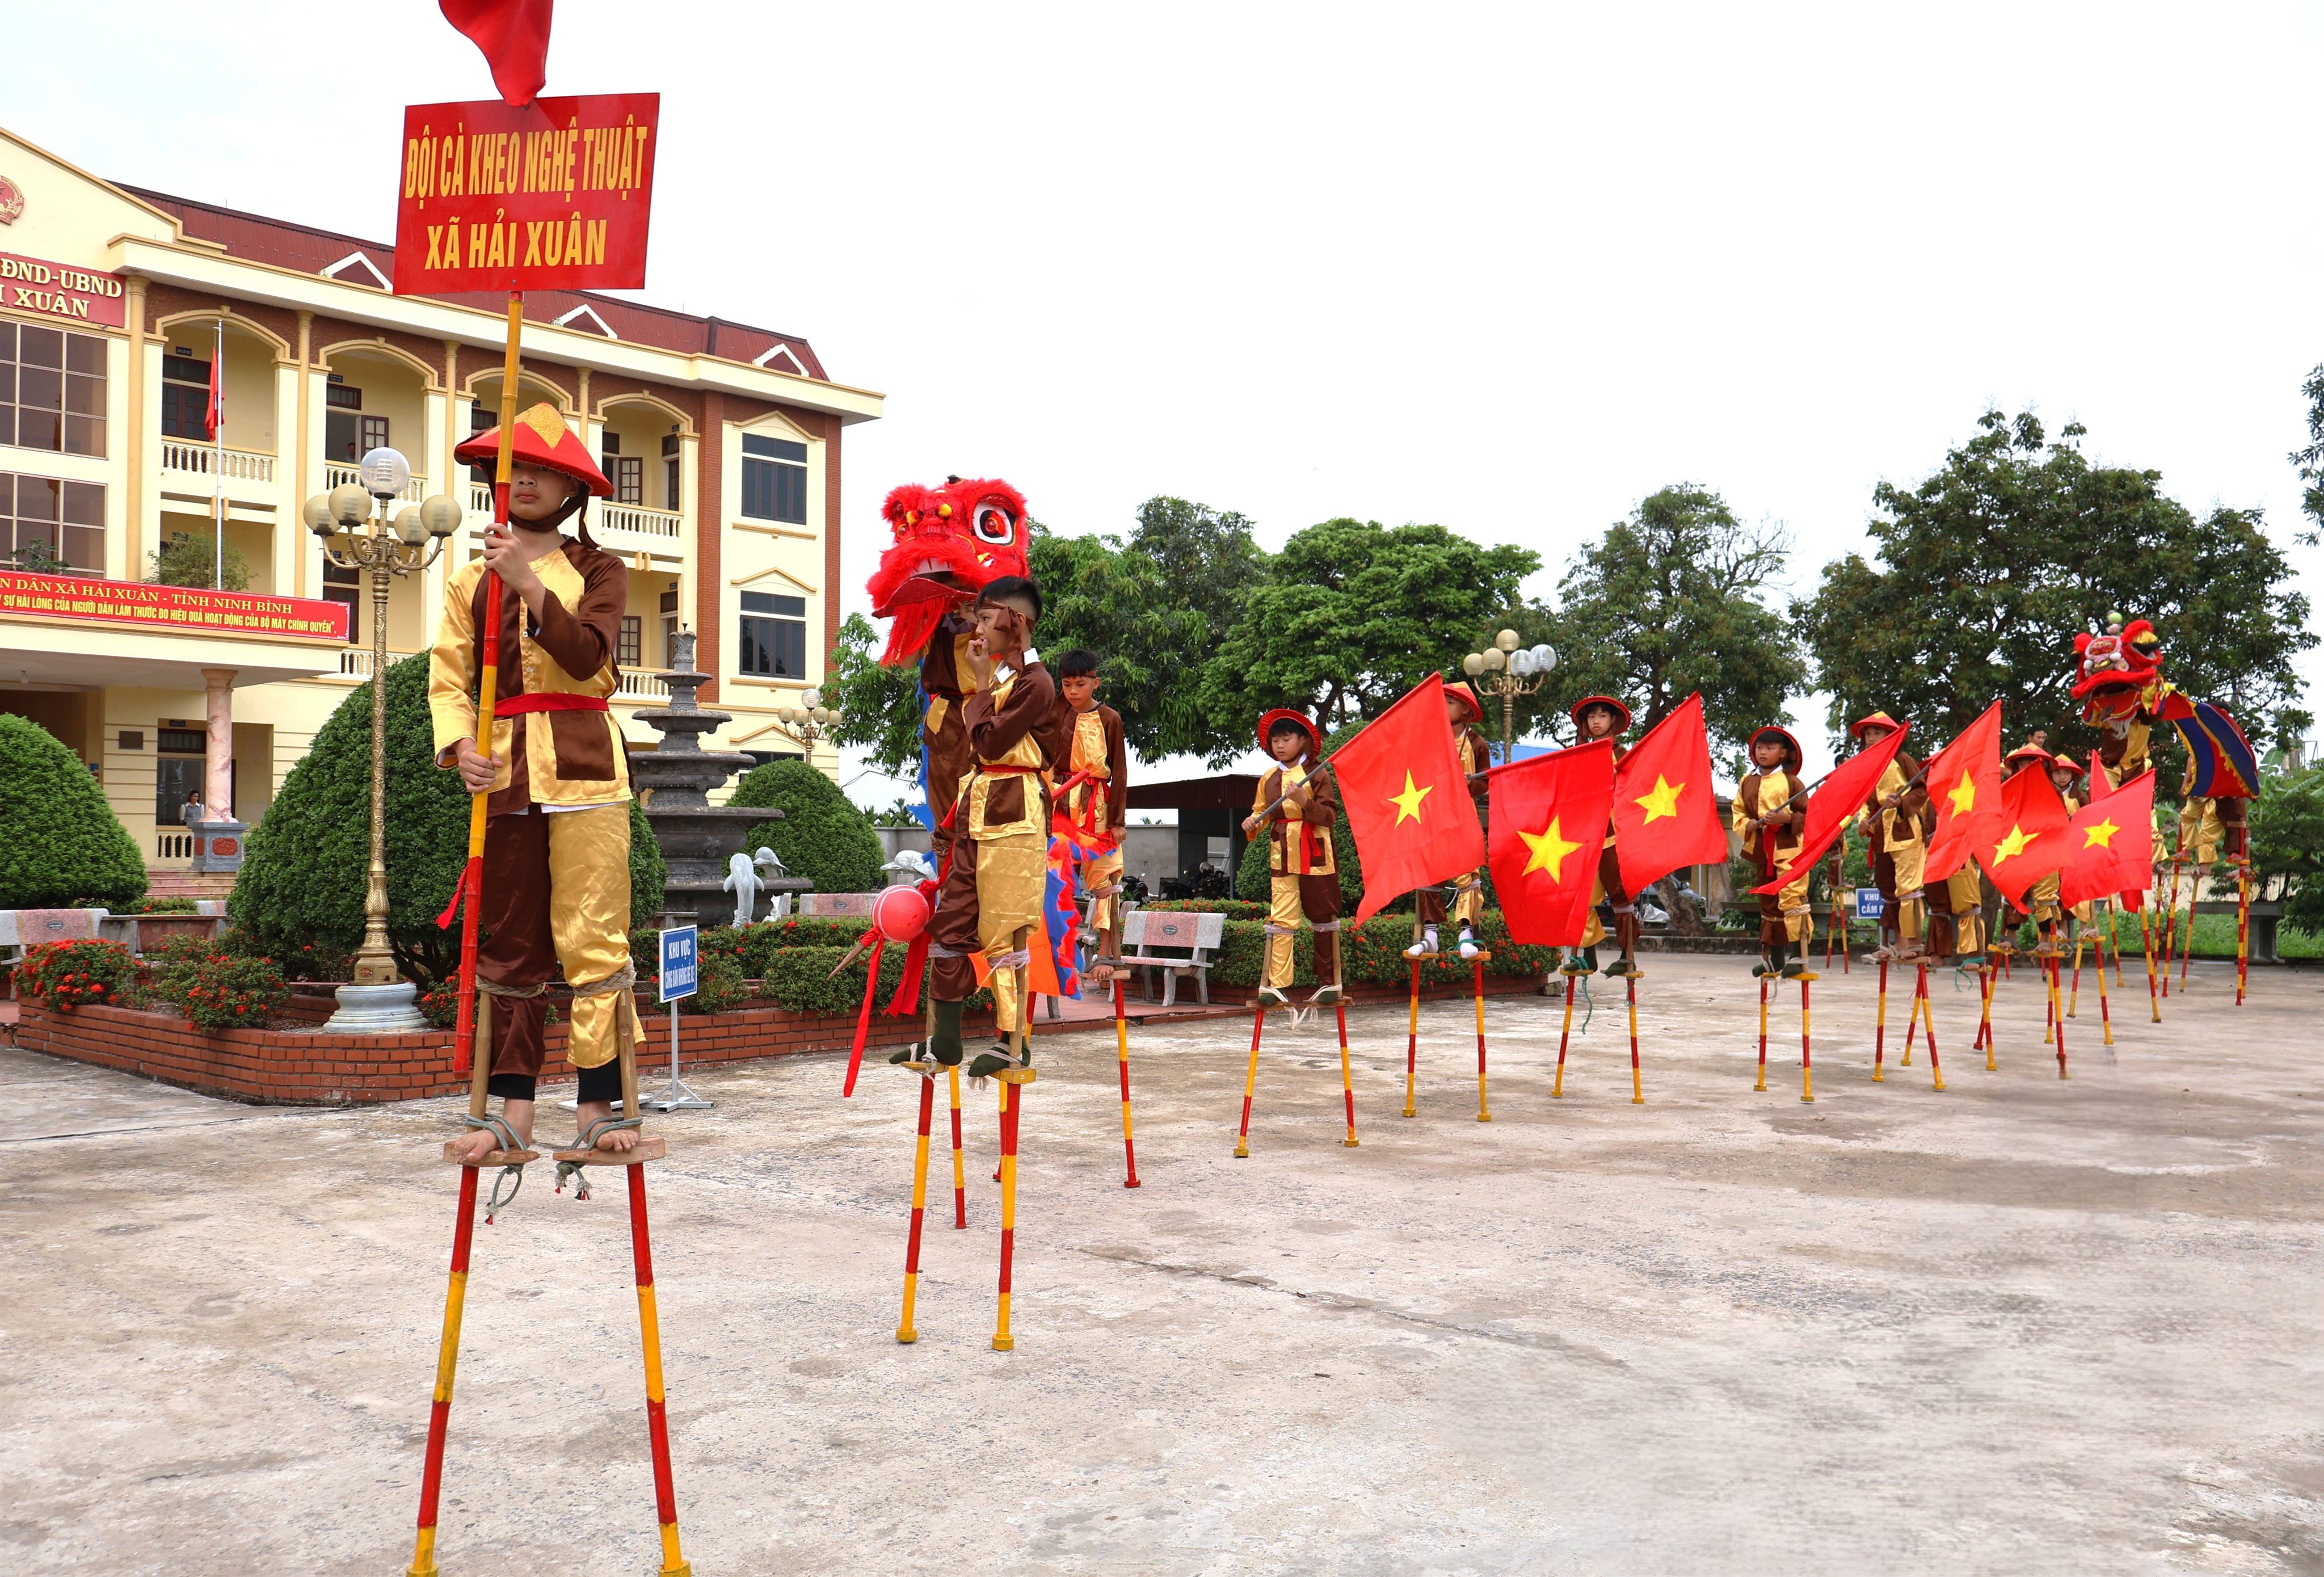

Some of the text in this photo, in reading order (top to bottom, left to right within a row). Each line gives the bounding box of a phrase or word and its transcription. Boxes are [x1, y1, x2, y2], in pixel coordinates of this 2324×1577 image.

[405, 114, 648, 209] ĐỘI CÀ KHEO NGHỆ THUẬT
[424, 208, 607, 270] XÃ HẢI XUÂN
[14, 290, 90, 318] XUÂN
[3, 594, 16, 609] SỰ
[16, 594, 30, 608] HÀI
[32, 594, 53, 609] LÒNG
[54, 596, 70, 611] CỦA
[72, 599, 96, 613] NGƯỜI
[98, 601, 113, 615] DÂN
[115, 603, 132, 616] LÀM
[133, 605, 157, 619] THƯỚC
[170, 607, 187, 623] HIỆU
[188, 608, 203, 623] QUẢ
[205, 612, 223, 626] HOẠT
[224, 612, 244, 627] ĐỘNG
[245, 613, 259, 627] CỦA
[260, 615, 270, 630] BỘ
[271, 616, 287, 629] MÁY
[288, 618, 308, 631] CHÍNH
[15, 577, 52, 592] DÂN
[54, 582, 78, 595] XÃ
[82, 583, 111, 598] HẢI
[114, 588, 159, 602] XUÂN
[171, 591, 209, 607] TỈNH
[213, 598, 252, 610] NINH
[256, 599, 293, 613] BÌNH
[669, 939, 691, 960] KHU VỰC
